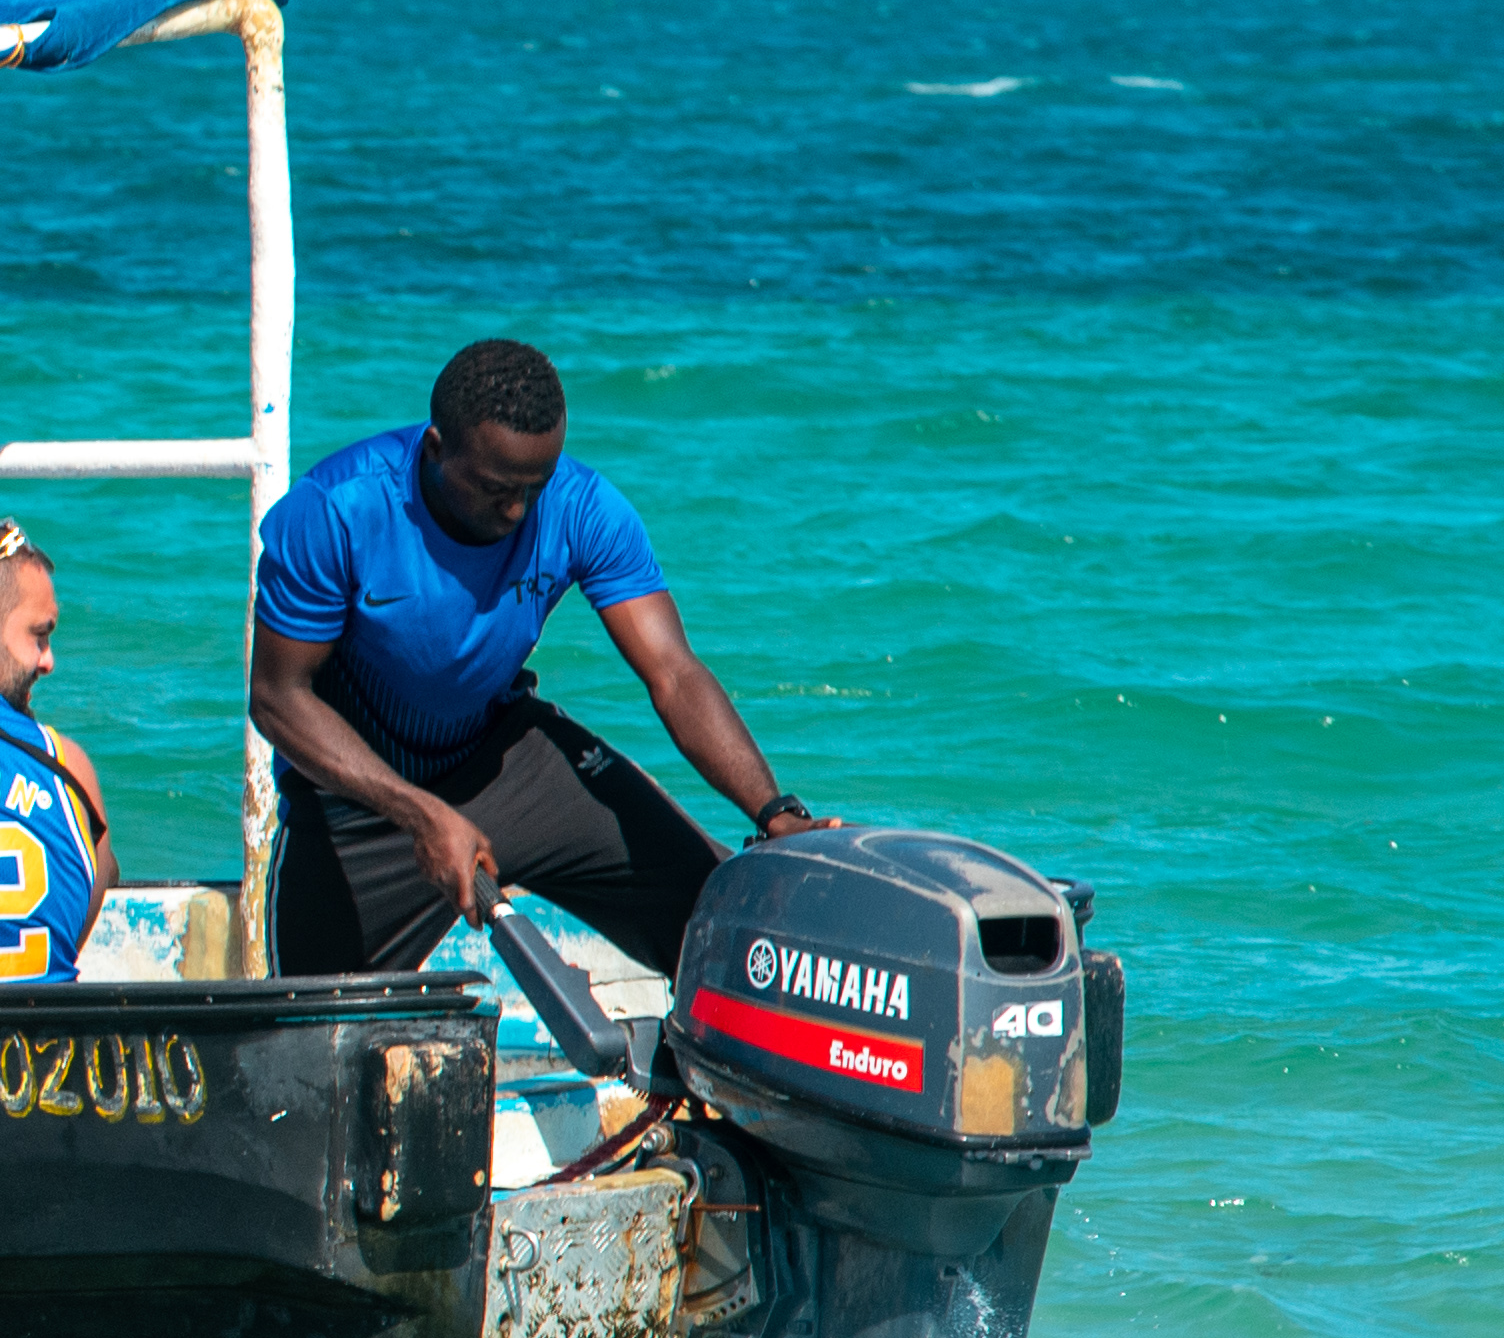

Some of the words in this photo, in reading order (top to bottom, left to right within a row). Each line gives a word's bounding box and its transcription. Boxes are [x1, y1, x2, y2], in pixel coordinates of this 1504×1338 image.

[780, 947, 910, 1021] YAMAHA
[992, 1000, 1064, 1038] 40
[829, 1039, 908, 1081] Enduro
